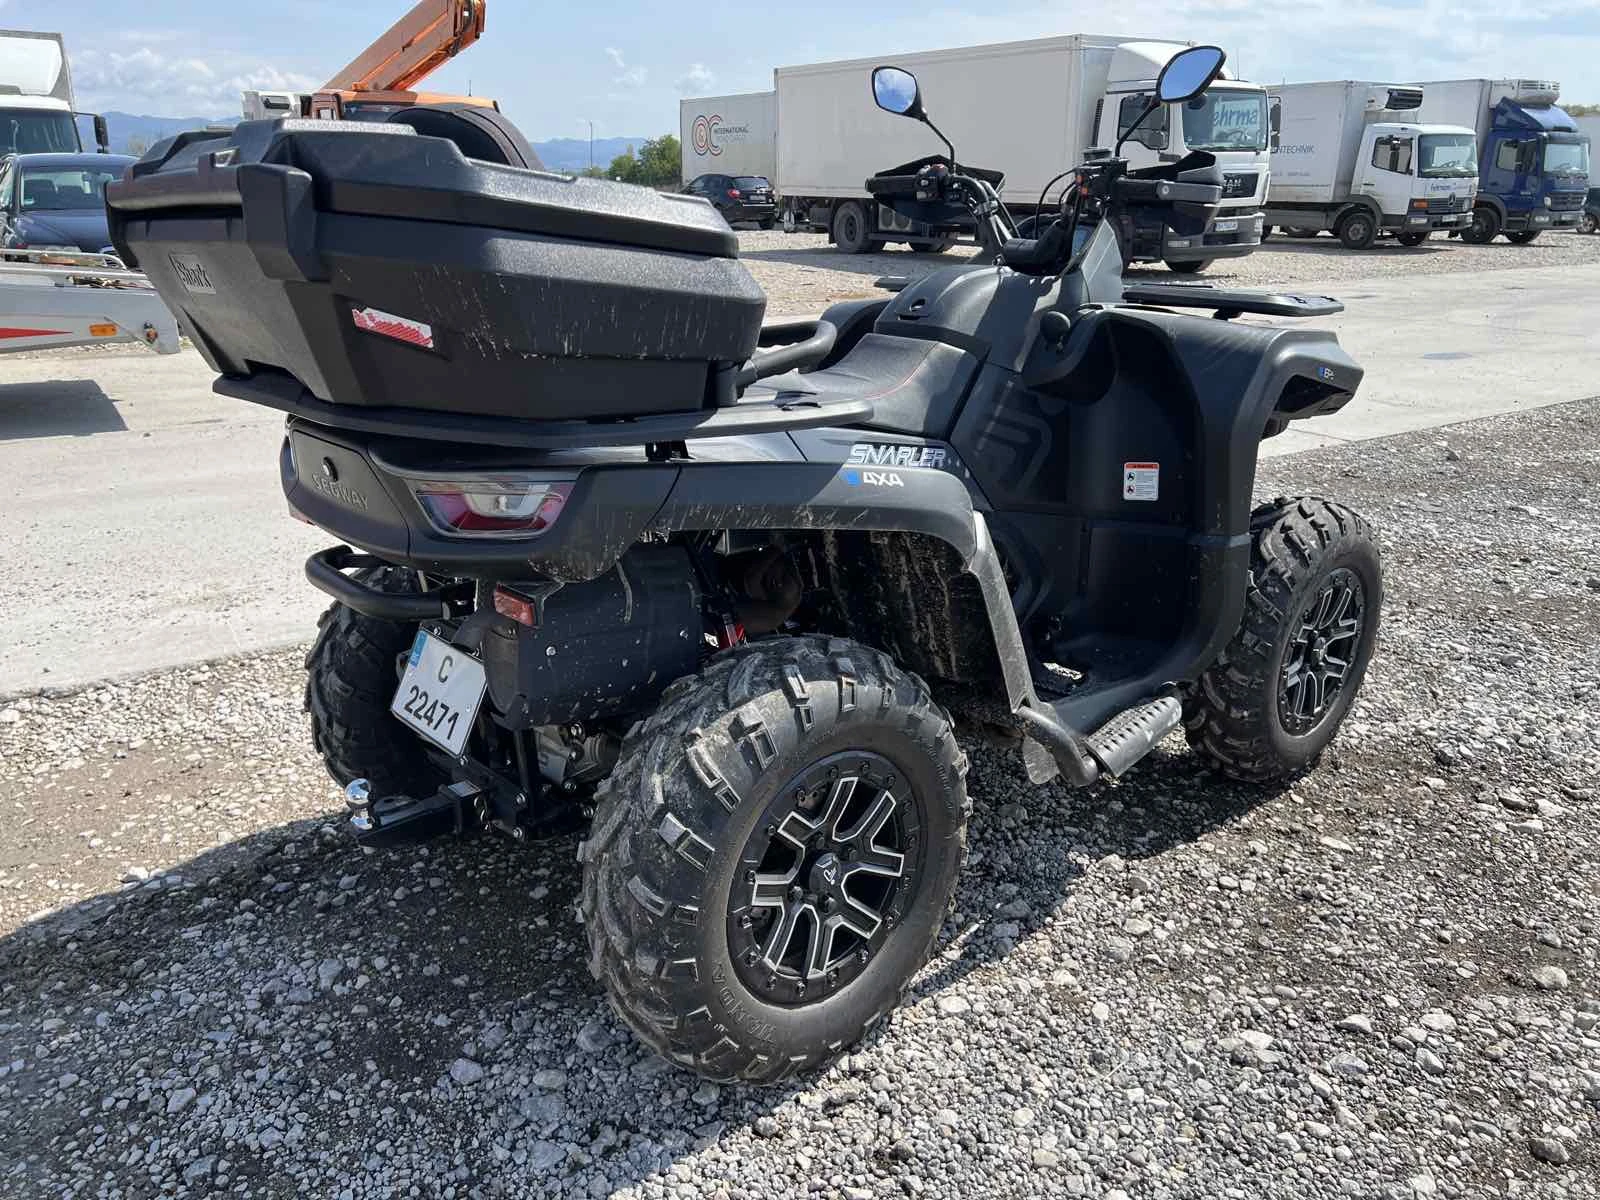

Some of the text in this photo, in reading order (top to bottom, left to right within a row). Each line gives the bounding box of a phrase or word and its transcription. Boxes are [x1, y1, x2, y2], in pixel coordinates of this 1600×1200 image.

[846, 443, 946, 468] SNARLER
[311, 472, 368, 511] SEGWAY
[438, 655, 453, 683] C
[404, 685, 460, 740] 22471
